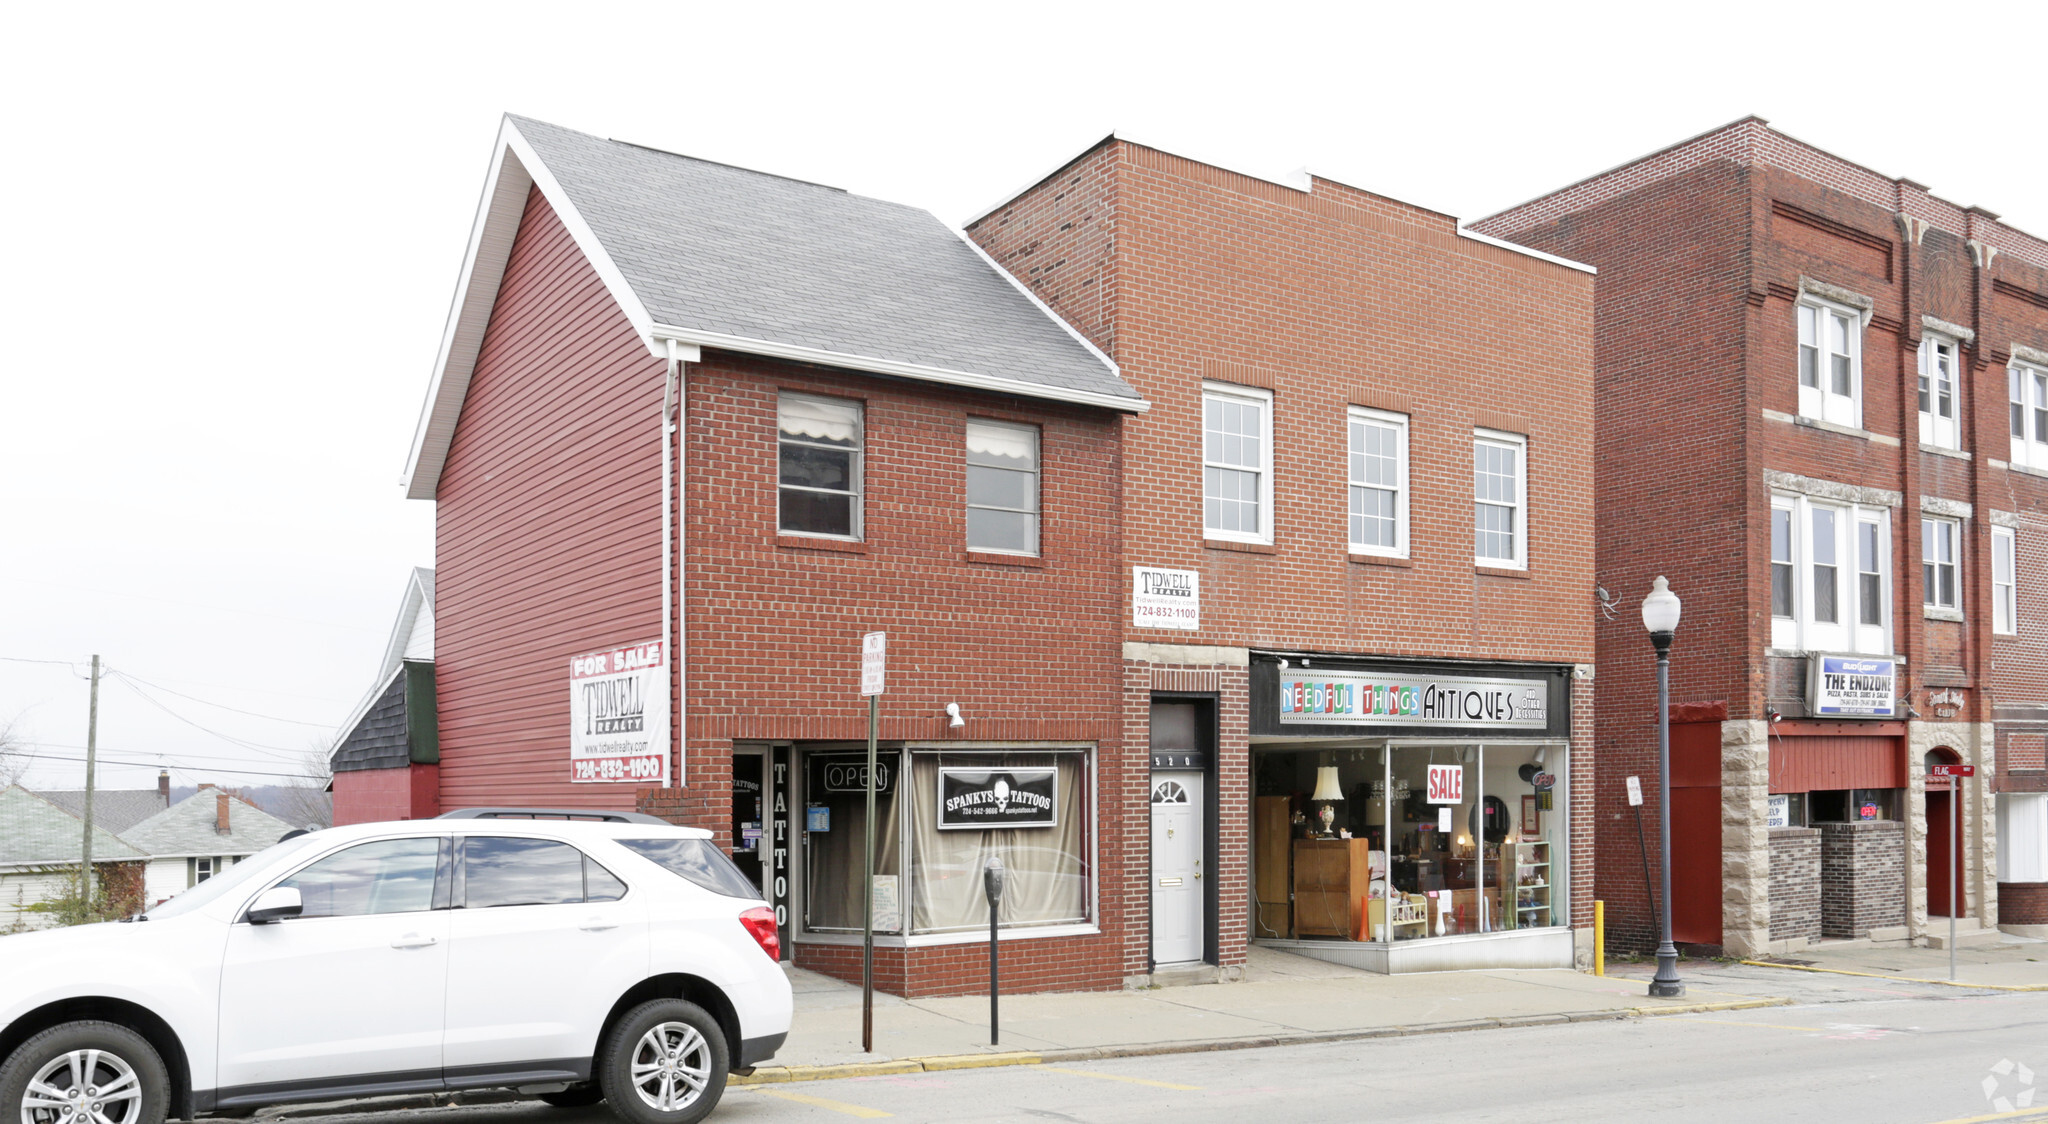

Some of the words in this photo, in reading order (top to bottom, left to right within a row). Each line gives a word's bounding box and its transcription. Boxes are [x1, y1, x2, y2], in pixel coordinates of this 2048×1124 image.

[1141, 571, 1191, 594] TIDWELL
[1153, 588, 1190, 597] REALTY
[1136, 605, 1196, 619] 724-832-1100
[870, 637, 878, 648] NO
[574, 654, 607, 677] FOR
[613, 644, 660, 672] SALE
[863, 651, 883, 663] PARKING
[1842, 662, 1858, 670] BUD
[1859, 663, 1878, 671] LIGHT
[1824, 674, 1846, 690] THE
[1849, 675, 1892, 692] ENDZONE
[582, 675, 644, 736] TIDWELL
[1282, 686, 1352, 710] NEEDFUL
[1363, 688, 1418, 712] THINGS
[1423, 683, 1513, 721] ANTIQUES
[1522, 697, 1540, 709] OTHER
[597, 718, 642, 733] REALTY
[585, 740, 649, 755] www.tidwellrealty.com
[575, 757, 660, 779] 724-832-1100
[1155, 756, 1190, 766] 520
[829, 767, 885, 787] OPEN
[1934, 766, 1949, 776] FLAG
[1429, 768, 1461, 800] SALE
[1534, 774, 1555, 786] OPEN
[946, 790, 994, 812] SPANKYS
[1010, 790, 1051, 810] TATTOOS
[1768, 808, 1780, 816] ELP
[1861, 806, 1877, 816] OPEN
[774, 763, 787, 927] TATTOO
